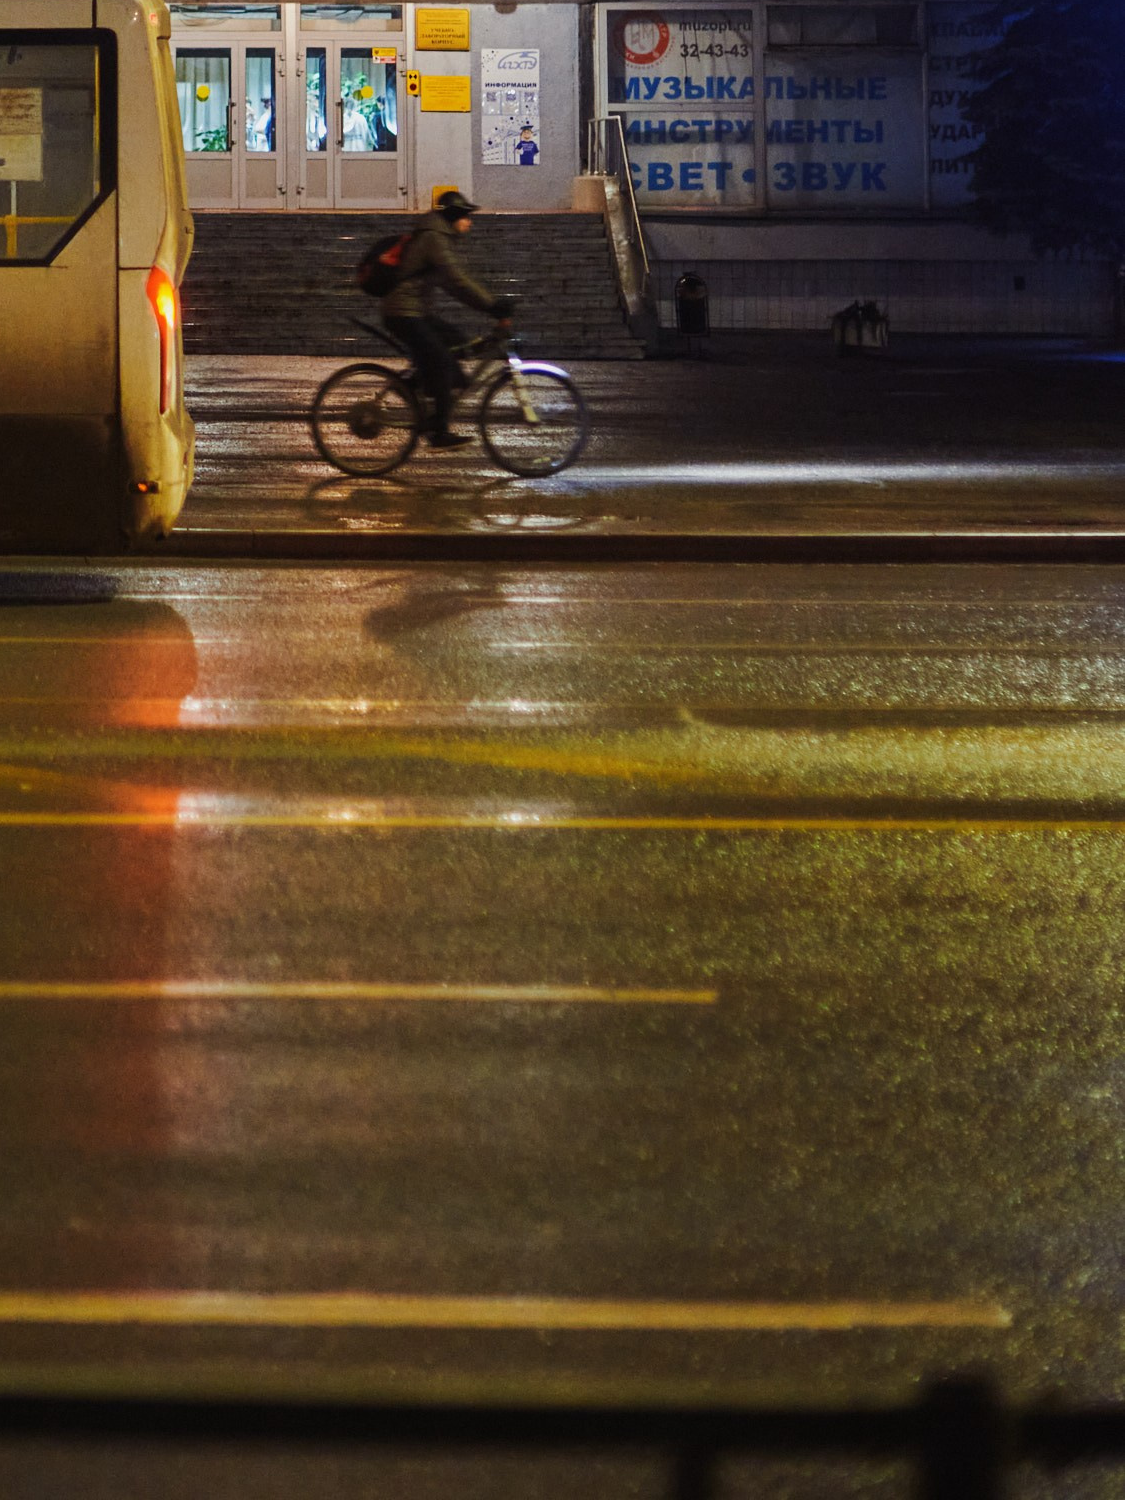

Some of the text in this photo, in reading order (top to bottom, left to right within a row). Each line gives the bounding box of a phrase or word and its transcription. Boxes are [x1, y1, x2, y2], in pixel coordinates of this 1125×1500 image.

[680, 44, 749, 57] 32-43-43
[614, 76, 887, 101] МУЗЫКАЛЬНЫЕ
[773, 161, 887, 191] ЗВУК
